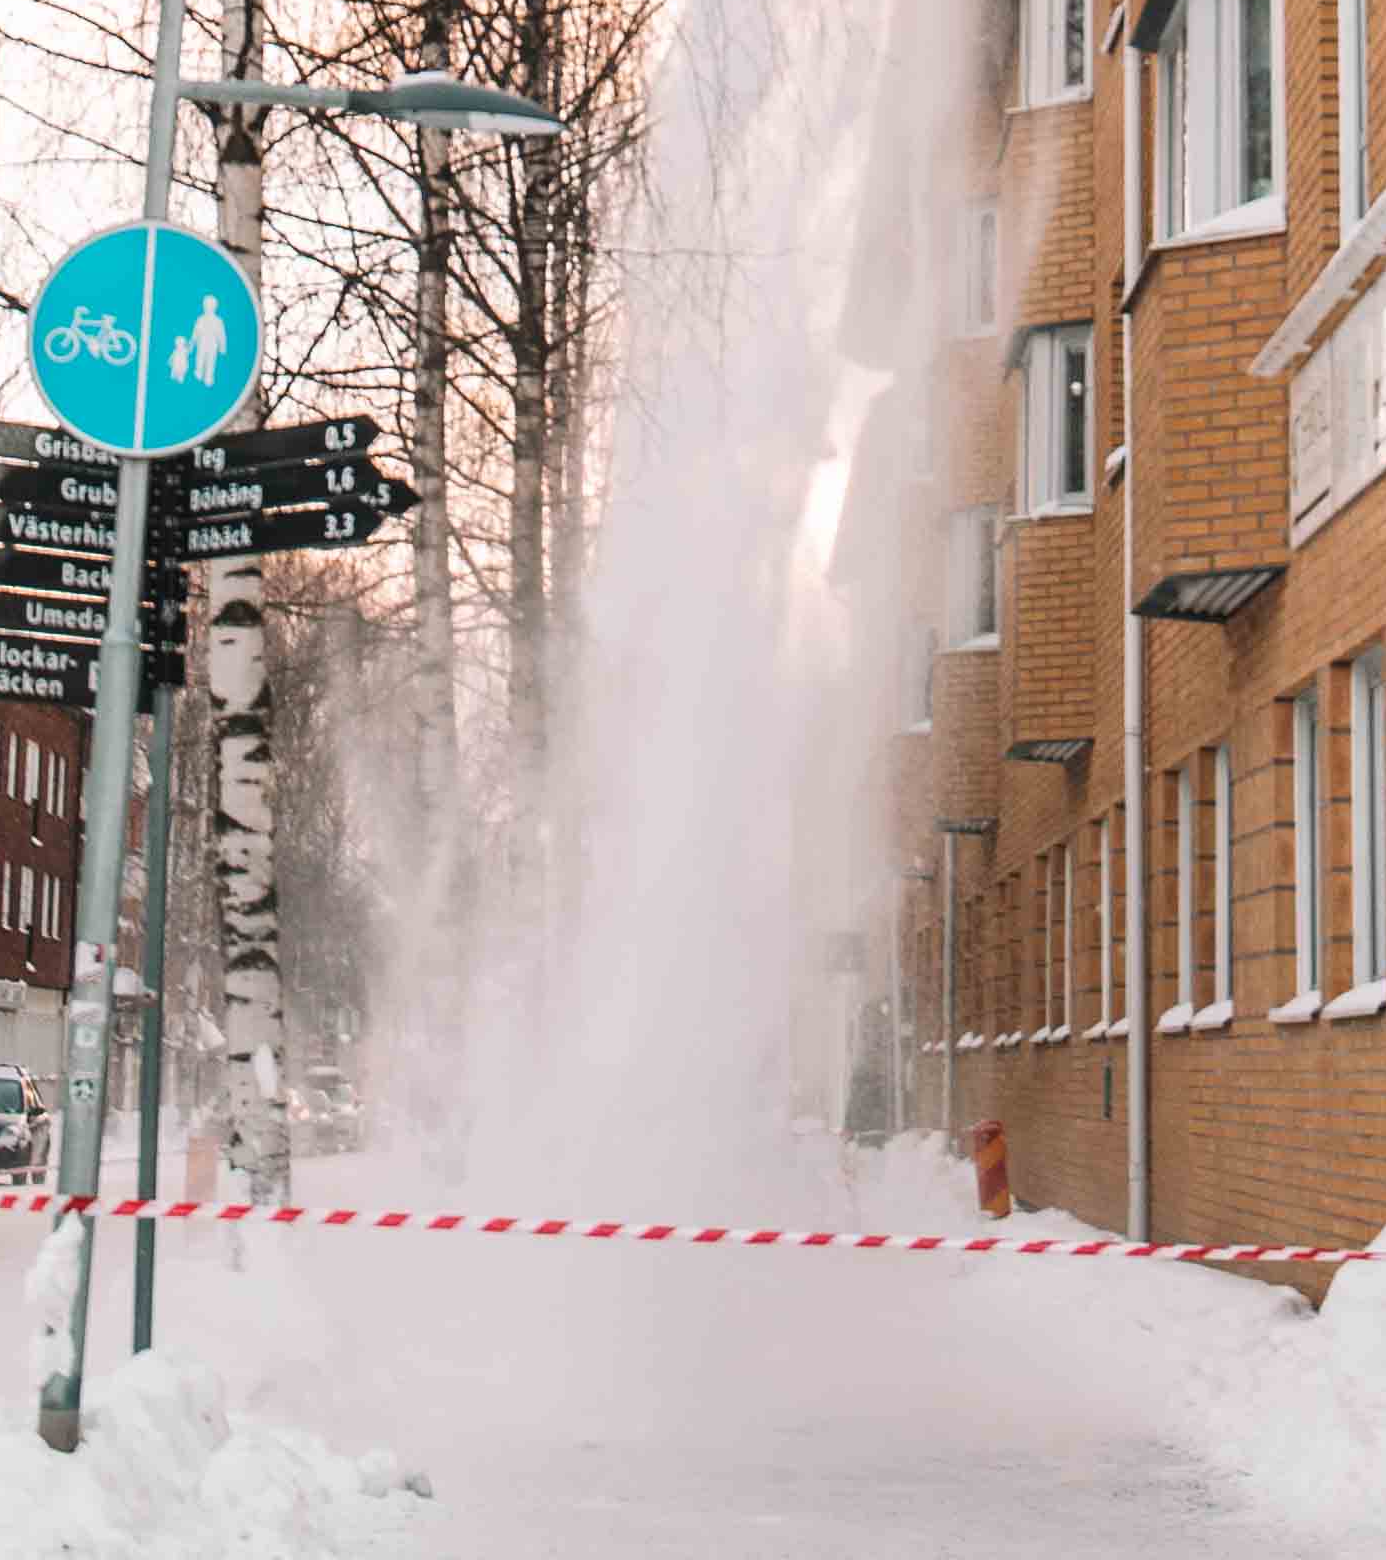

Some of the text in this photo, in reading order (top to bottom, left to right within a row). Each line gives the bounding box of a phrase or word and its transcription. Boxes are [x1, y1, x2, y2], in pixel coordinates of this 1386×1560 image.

[35, 431, 118, 466] Grisba
[193, 445, 227, 473] Teg
[61, 476, 117, 506] Grub
[7, 511, 117, 546] Västerhis
[188, 522, 254, 552] Röbäck
[61, 561, 113, 591] Back
[25, 600, 107, 631] Umeda
